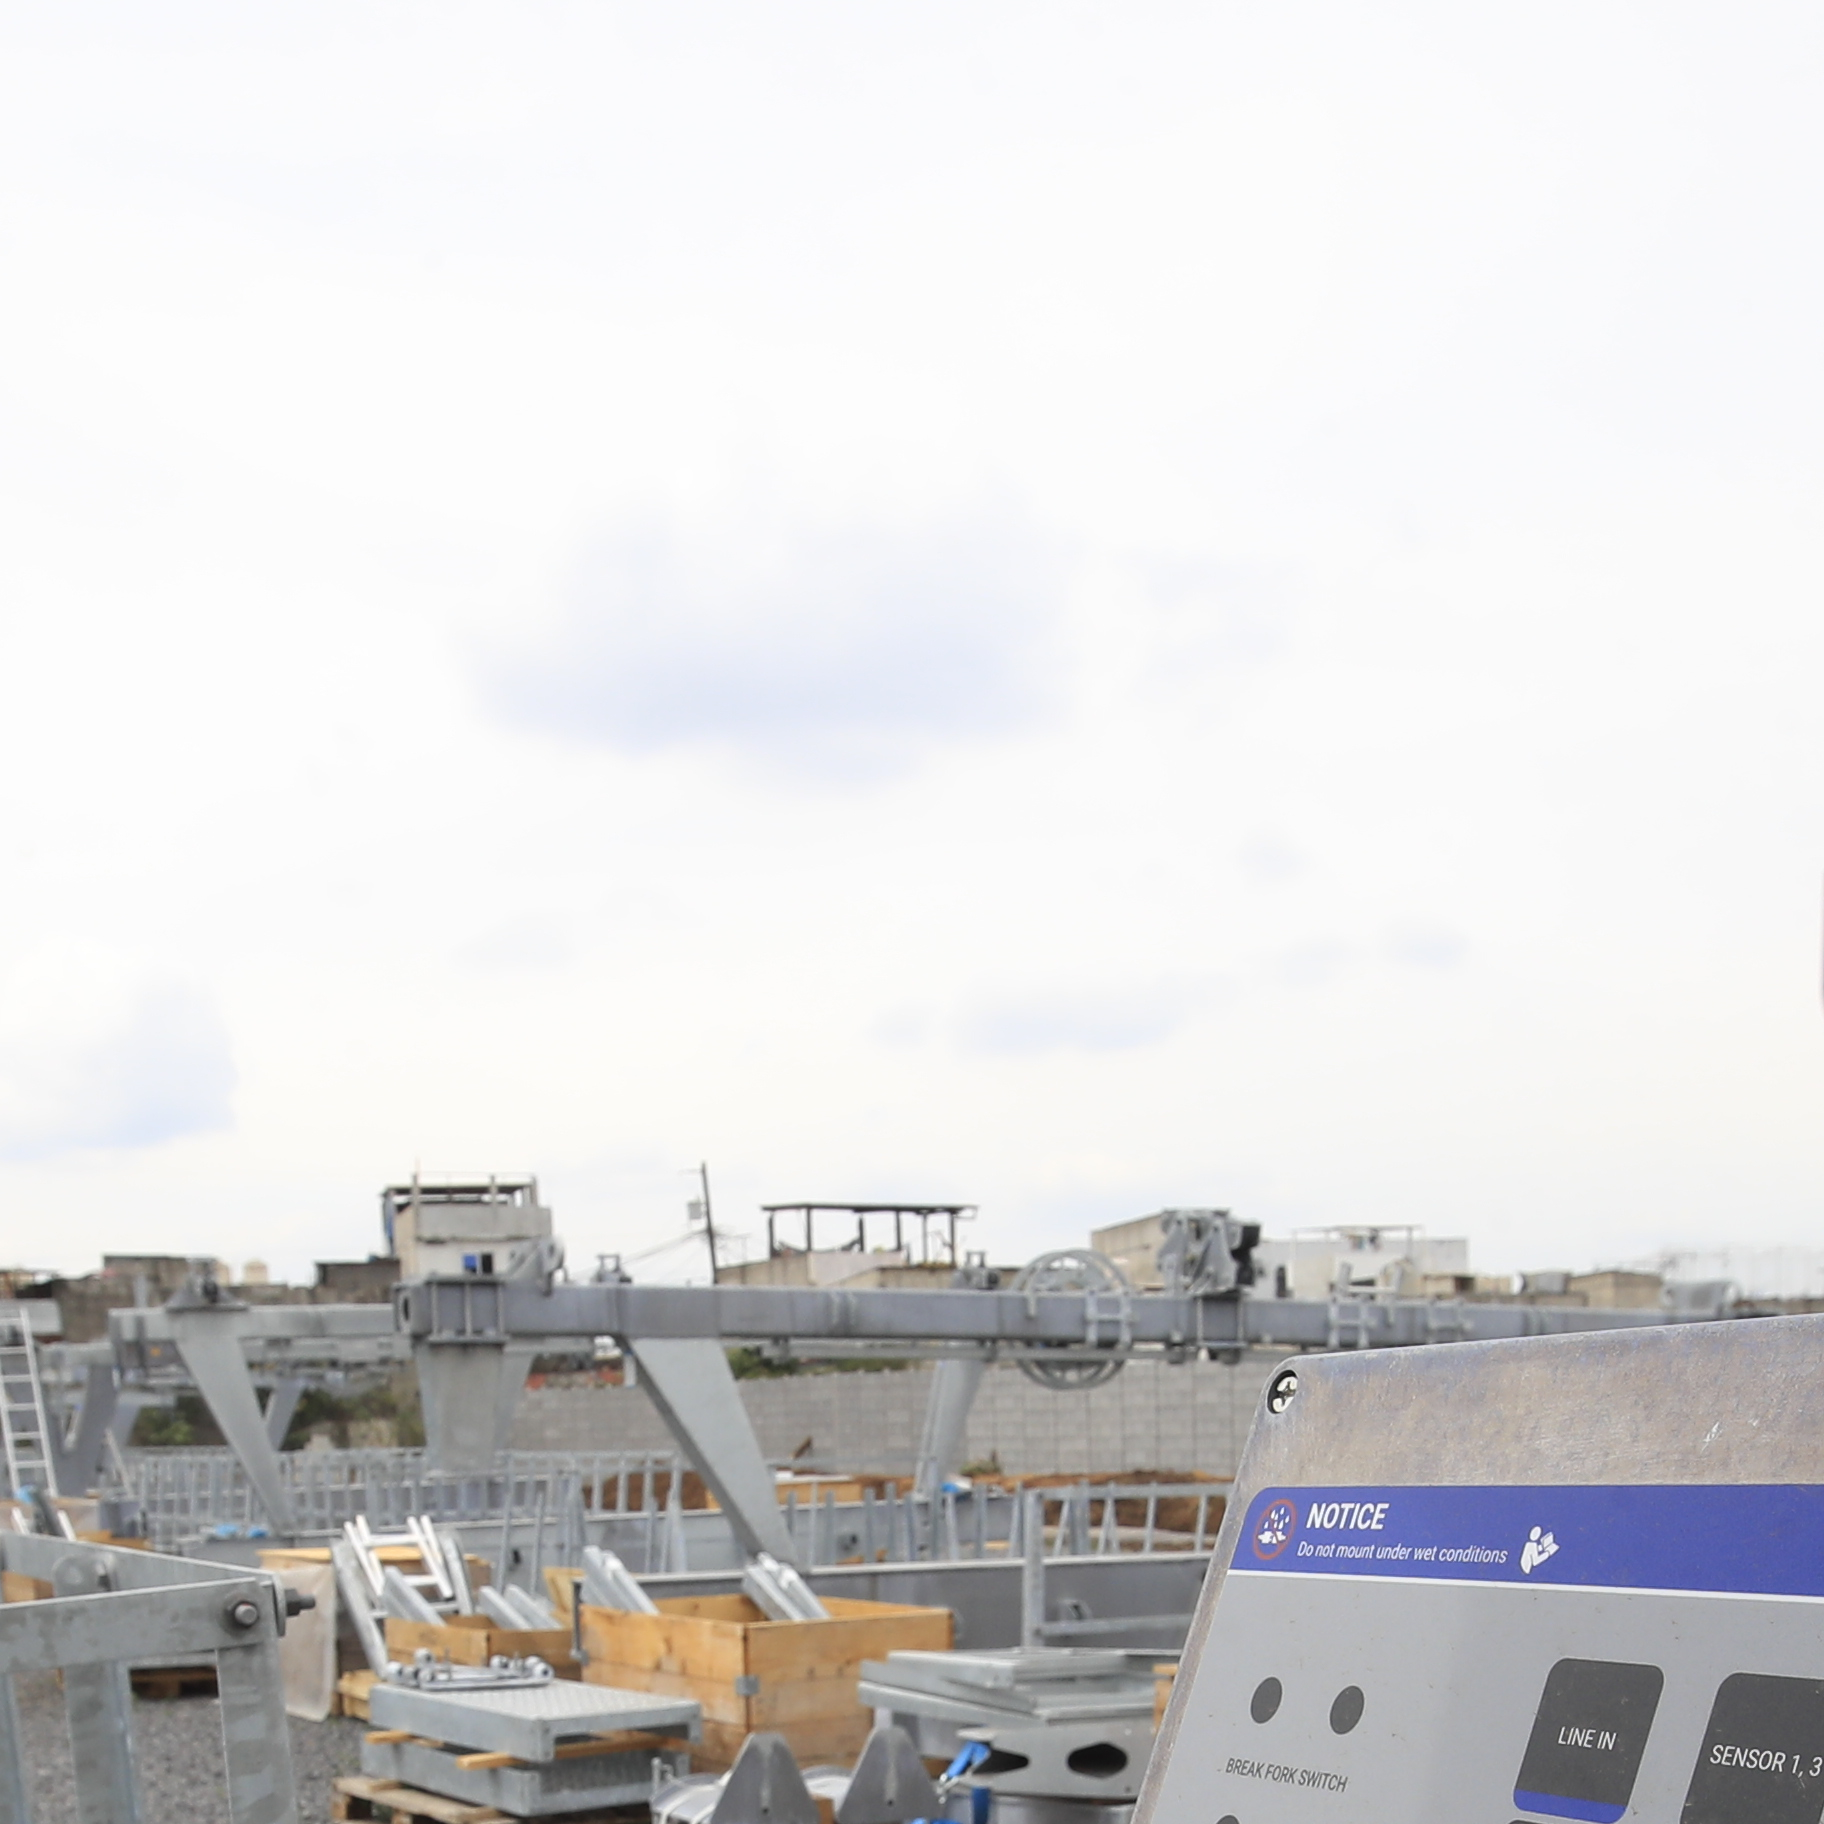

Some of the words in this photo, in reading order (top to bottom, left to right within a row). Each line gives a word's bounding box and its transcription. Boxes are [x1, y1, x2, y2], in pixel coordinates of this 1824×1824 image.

[1305, 1502, 1390, 1531] NOTICE
[1297, 1541, 1314, 1558] Do
[1315, 1543, 1335, 1558] not
[1336, 1545, 1375, 1559] mount
[1375, 1544, 1412, 1561] under
[1413, 1547, 1437, 1561] wet
[1439, 1545, 1508, 1563] conditions
[1558, 1726, 1596, 1749] LINE
[1597, 1730, 1617, 1750] IN
[1225, 1757, 1265, 1779] BREAK
[1264, 1764, 1298, 1784] FORK
[1298, 1769, 1348, 1792] SWITCH
[1709, 1744, 1786, 1773] SENSOR
[1791, 1755, 1804, 1778] 1,
[1809, 1756, 1823, 1777] 3
